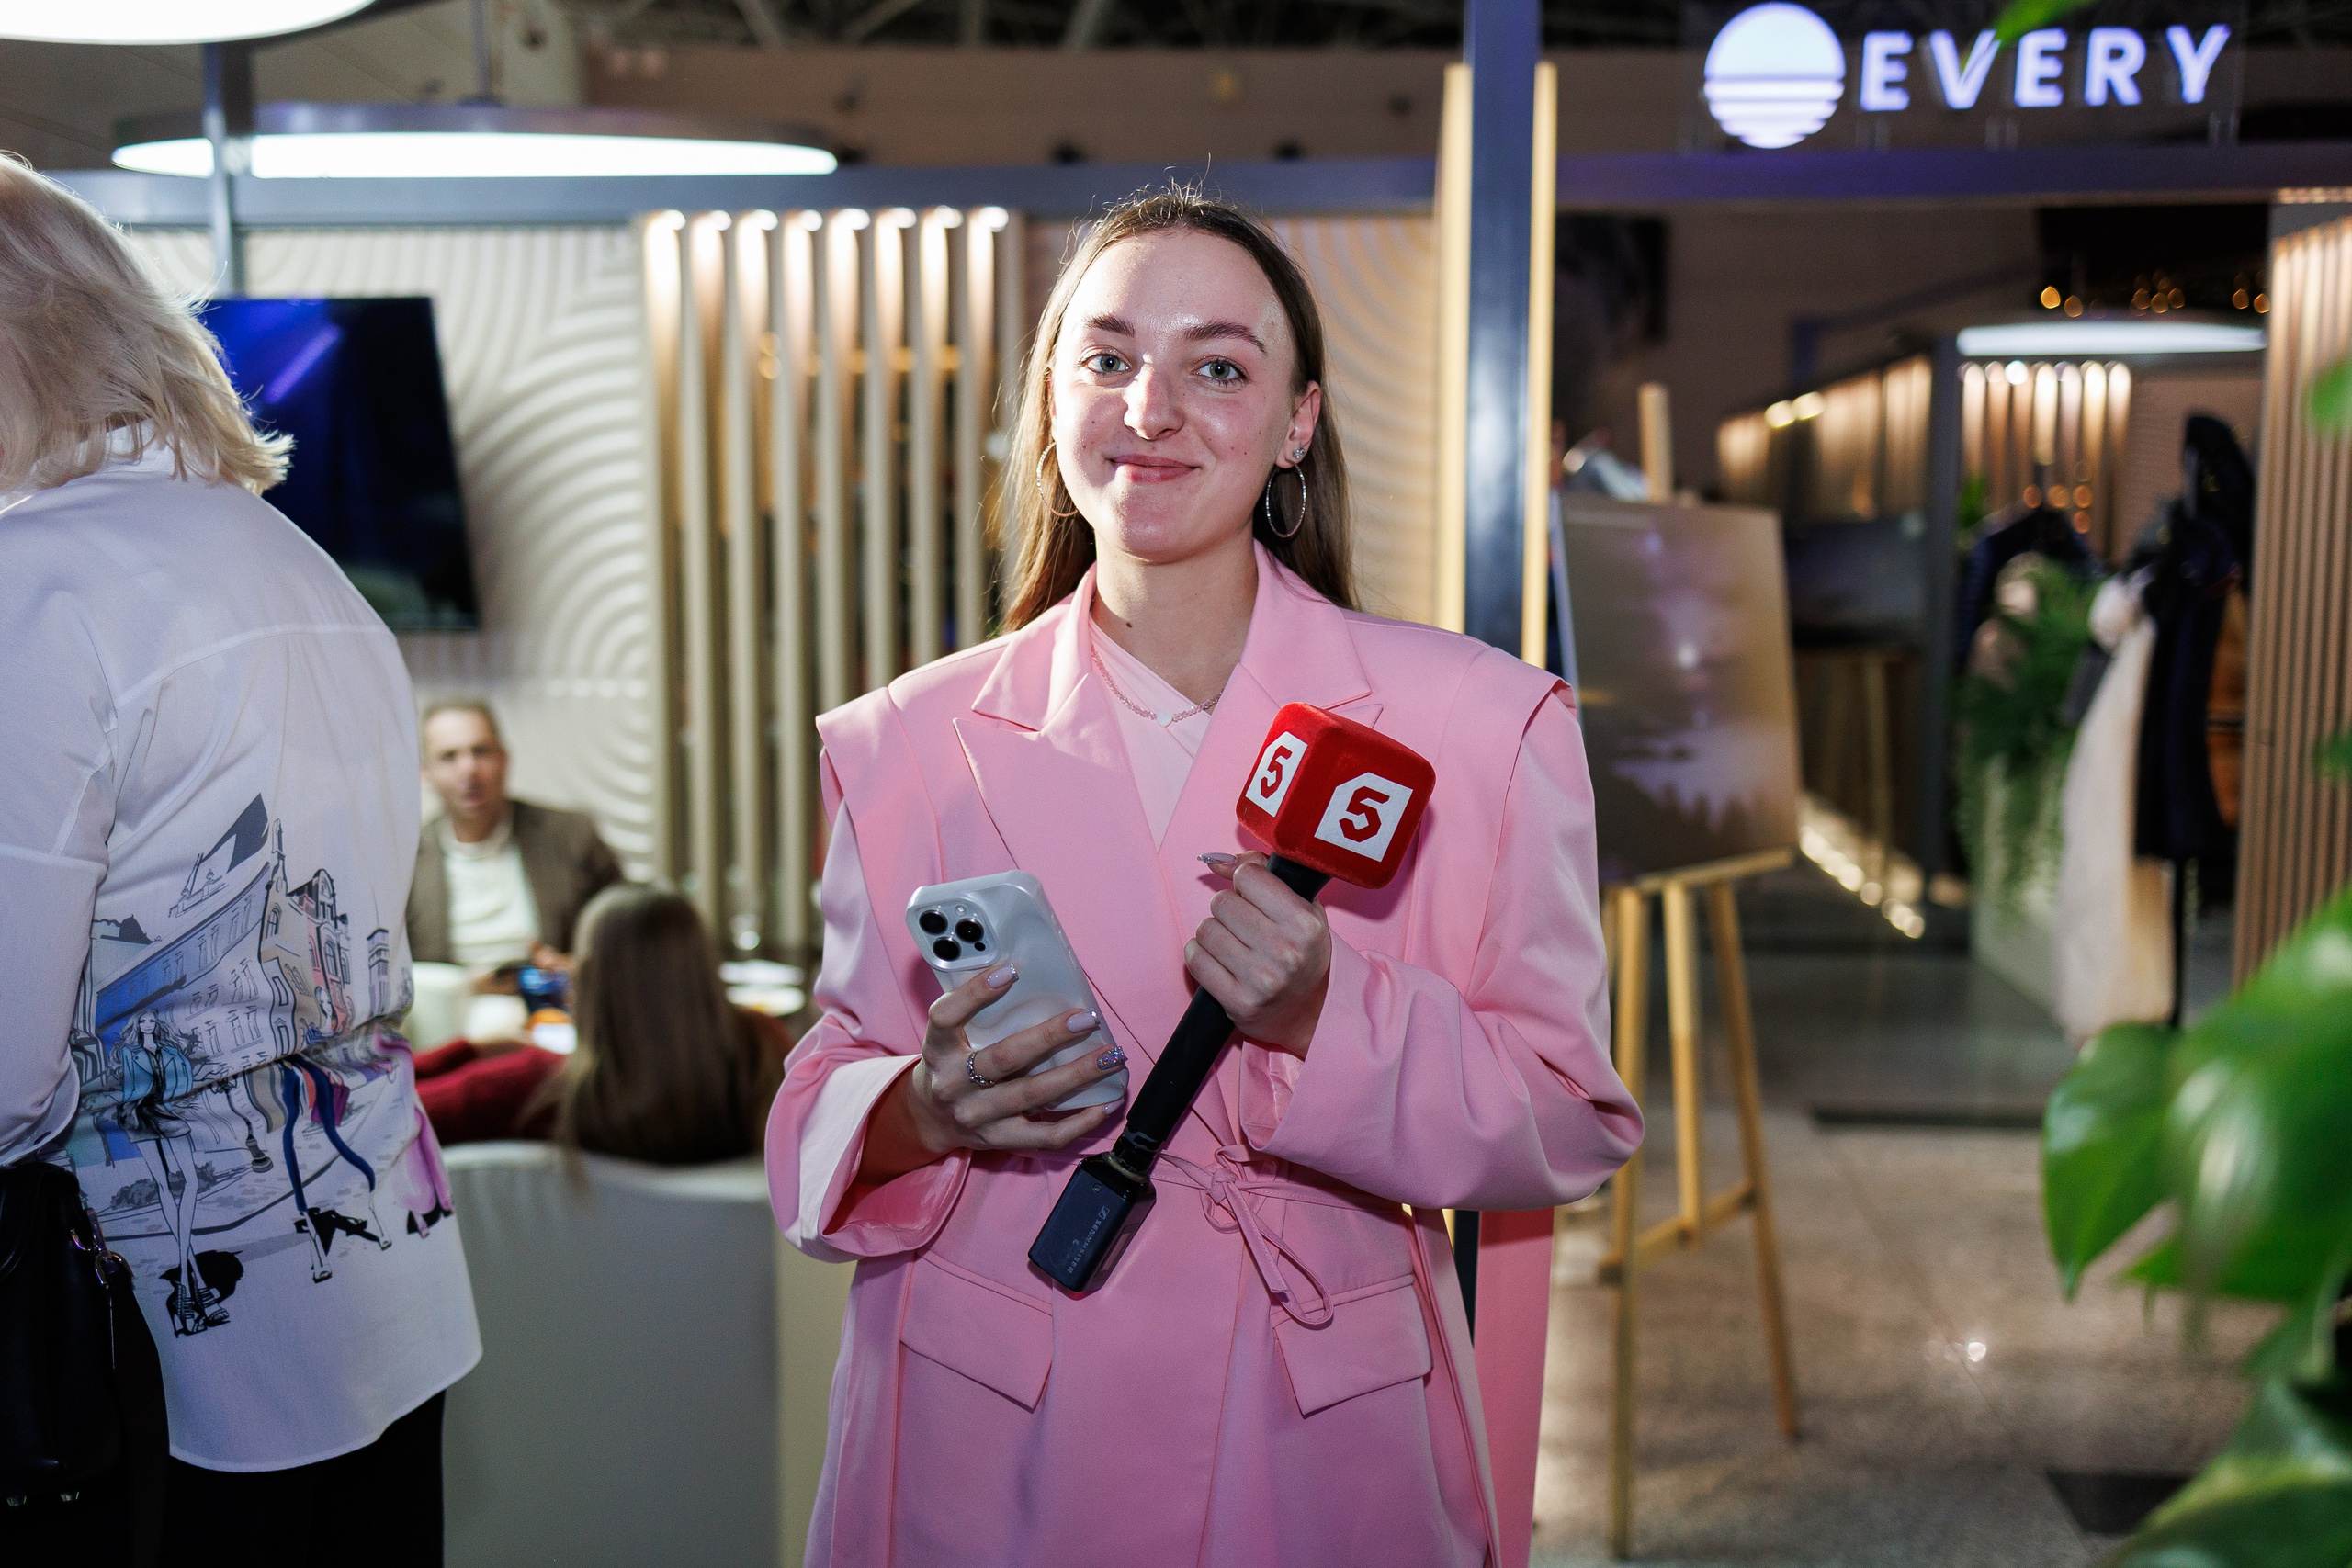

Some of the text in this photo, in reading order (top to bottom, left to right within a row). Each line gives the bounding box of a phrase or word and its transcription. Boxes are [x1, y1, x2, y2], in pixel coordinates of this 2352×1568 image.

[1859, 23, 2232, 111] EVERY
[1260, 745, 1294, 799] 5
[1339, 785, 1391, 843] 5
